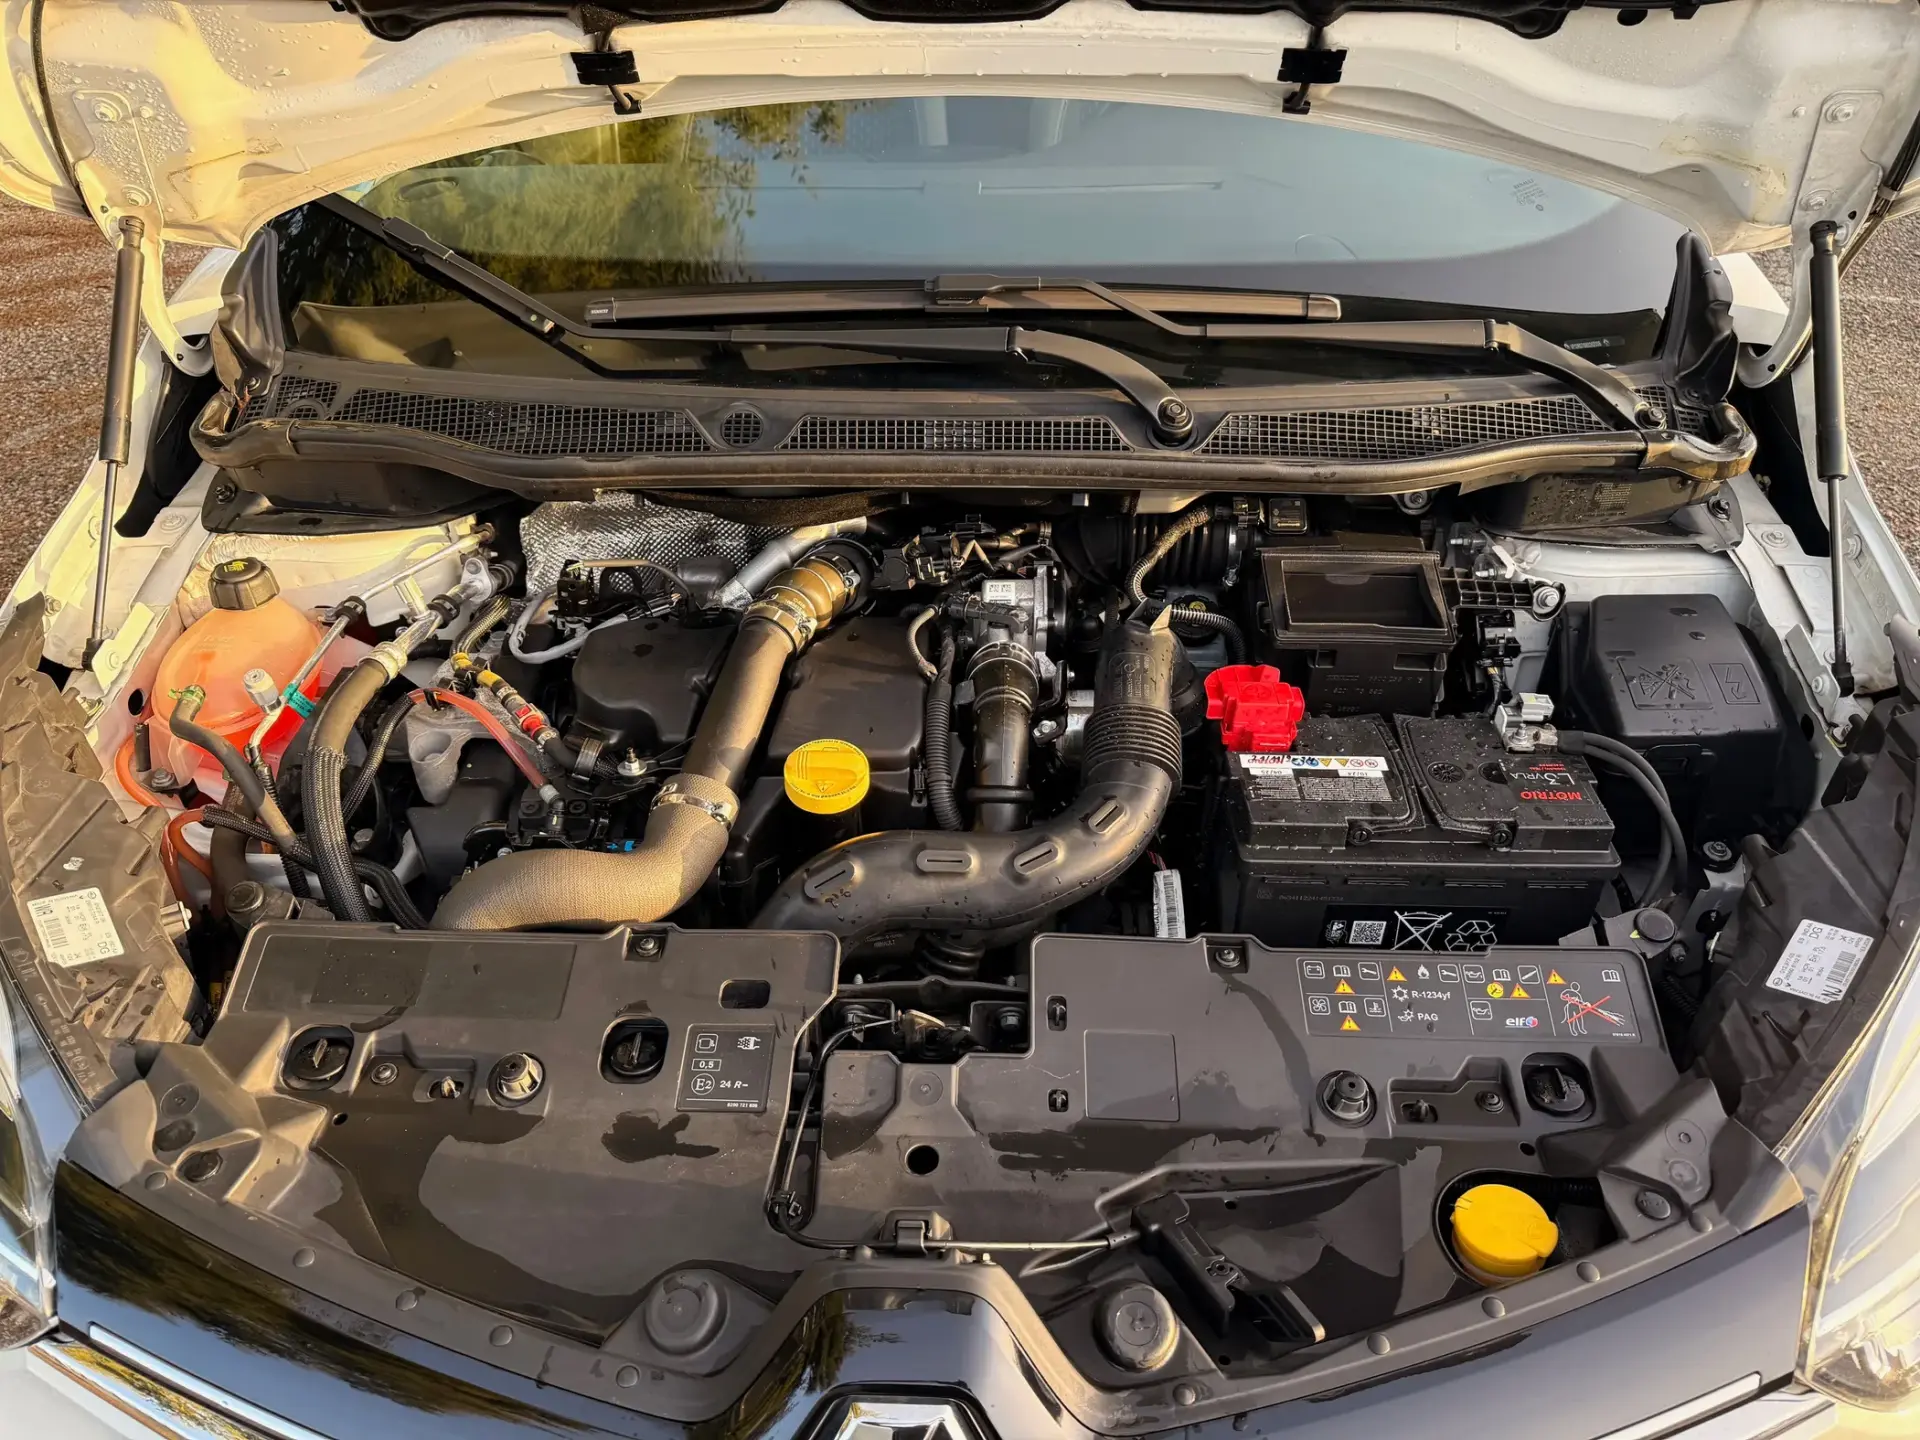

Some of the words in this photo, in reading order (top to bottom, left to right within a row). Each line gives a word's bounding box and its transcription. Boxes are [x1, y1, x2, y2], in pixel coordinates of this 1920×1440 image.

[1520, 791, 1582, 800] MOTRIO
[1809, 926, 1823, 940] DG
[97, 941, 110, 955] DG
[1411, 990, 1451, 999] R-1234yf
[1417, 1012, 1439, 1021] PAG
[1505, 1017, 1526, 1026] elf
[699, 1060, 714, 1069] 0,5
[695, 1078, 712, 1091] E2
[719, 1080, 731, 1089] 24
